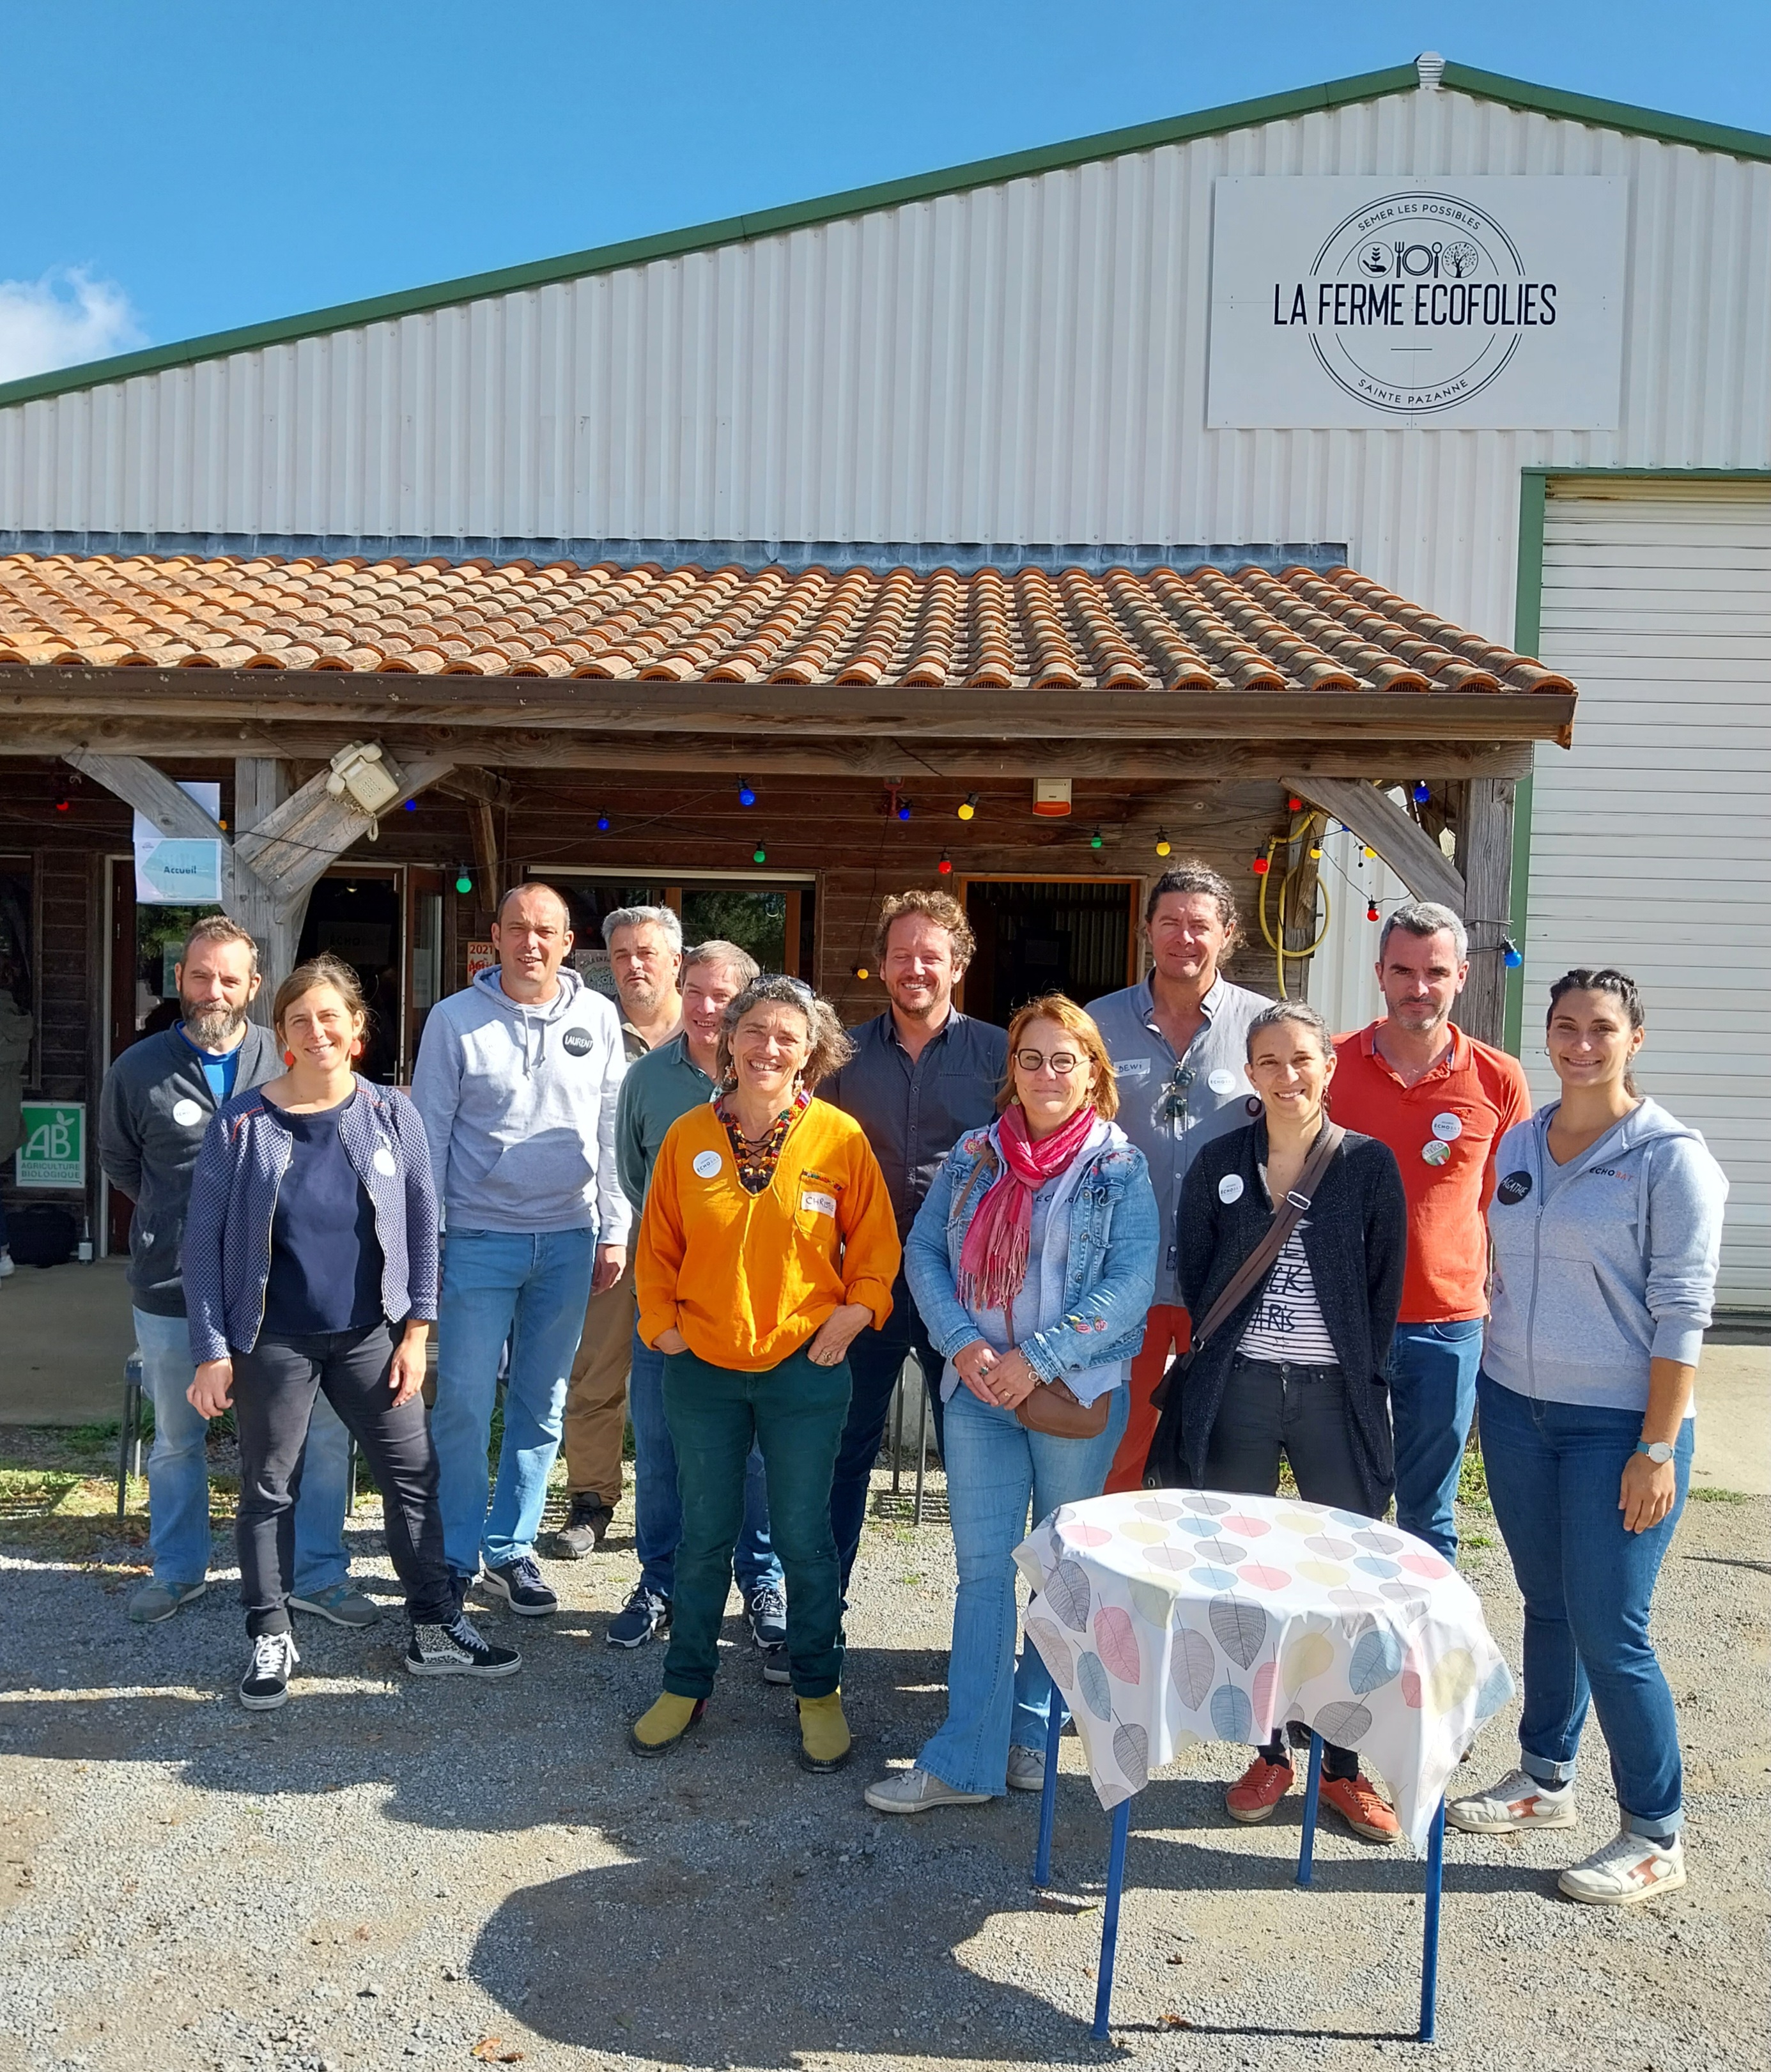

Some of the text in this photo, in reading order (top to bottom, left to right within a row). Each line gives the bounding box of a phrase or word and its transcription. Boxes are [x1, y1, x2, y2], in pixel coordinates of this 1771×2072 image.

[1358, 204, 1481, 231] SEMER LES POSSIBLES
[1274, 283, 1557, 326] LA FERME ECOFOLIES
[1358, 379, 1469, 404] SAINTE PAZANNE
[164, 865, 197, 874] Accueil
[469, 944, 493, 955] 2021
[564, 1035, 593, 1049] LAURENT
[25, 1123, 71, 1159] AB
[1423, 1142, 1444, 1157] STEICO
[21, 1162, 80, 1171] AGRICULTURE
[21, 1170, 81, 1179] BIOLOGIQUE
[1501, 1177, 1529, 1196] AGATHE
